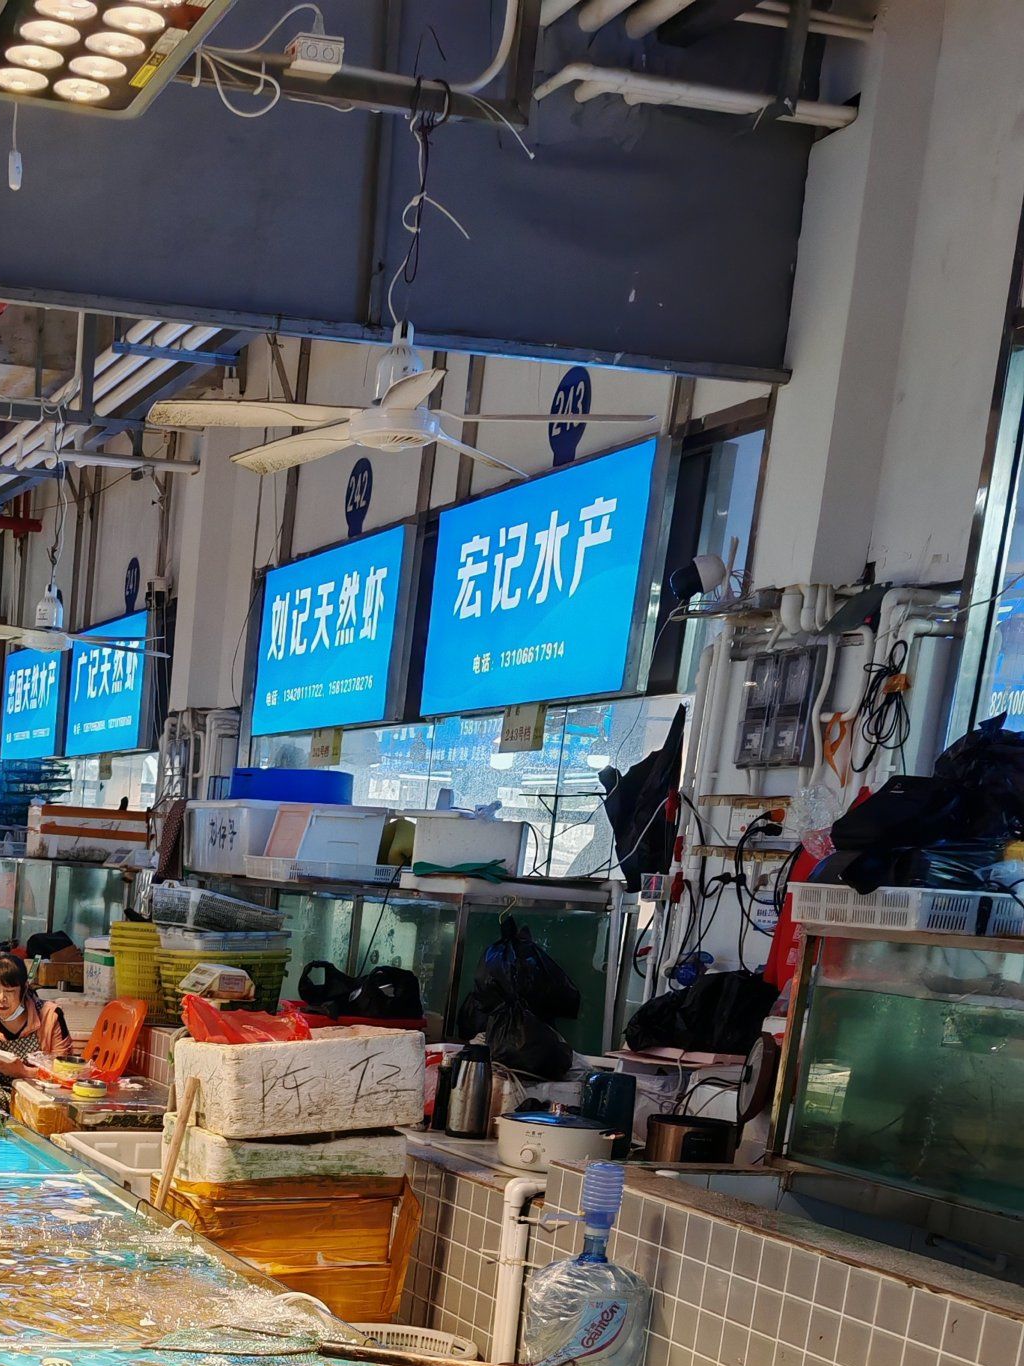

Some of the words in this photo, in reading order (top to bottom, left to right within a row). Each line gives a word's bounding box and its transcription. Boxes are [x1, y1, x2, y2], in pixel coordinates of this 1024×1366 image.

[552, 380, 585, 436] 243
[346, 470, 369, 512] 242
[453, 496, 618, 620] 宏记水产
[267, 565, 388, 662] 刘记天然虾
